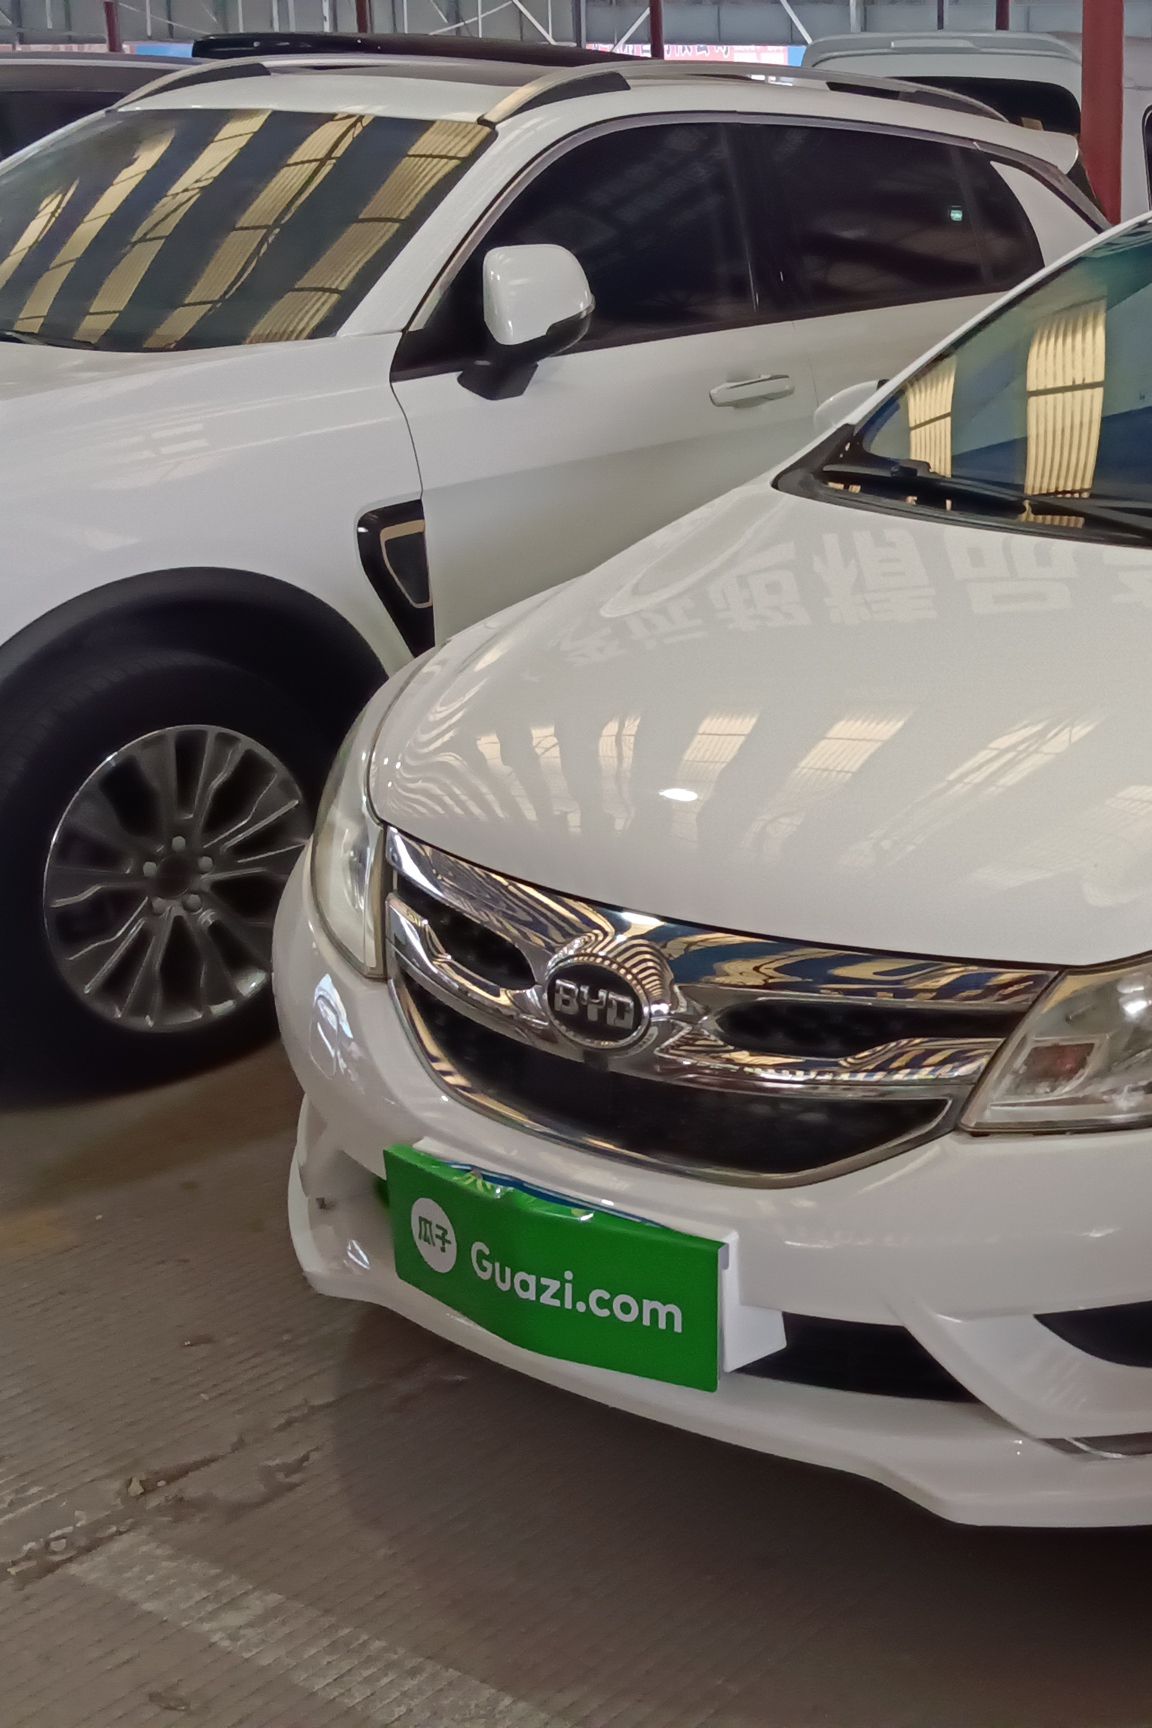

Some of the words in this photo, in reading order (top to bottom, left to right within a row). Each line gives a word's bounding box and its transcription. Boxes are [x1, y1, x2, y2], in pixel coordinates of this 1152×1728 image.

[554, 979, 635, 1030] BYD
[416, 1215, 452, 1253] 瓜子
[470, 1241, 683, 1334] Guazi.com
